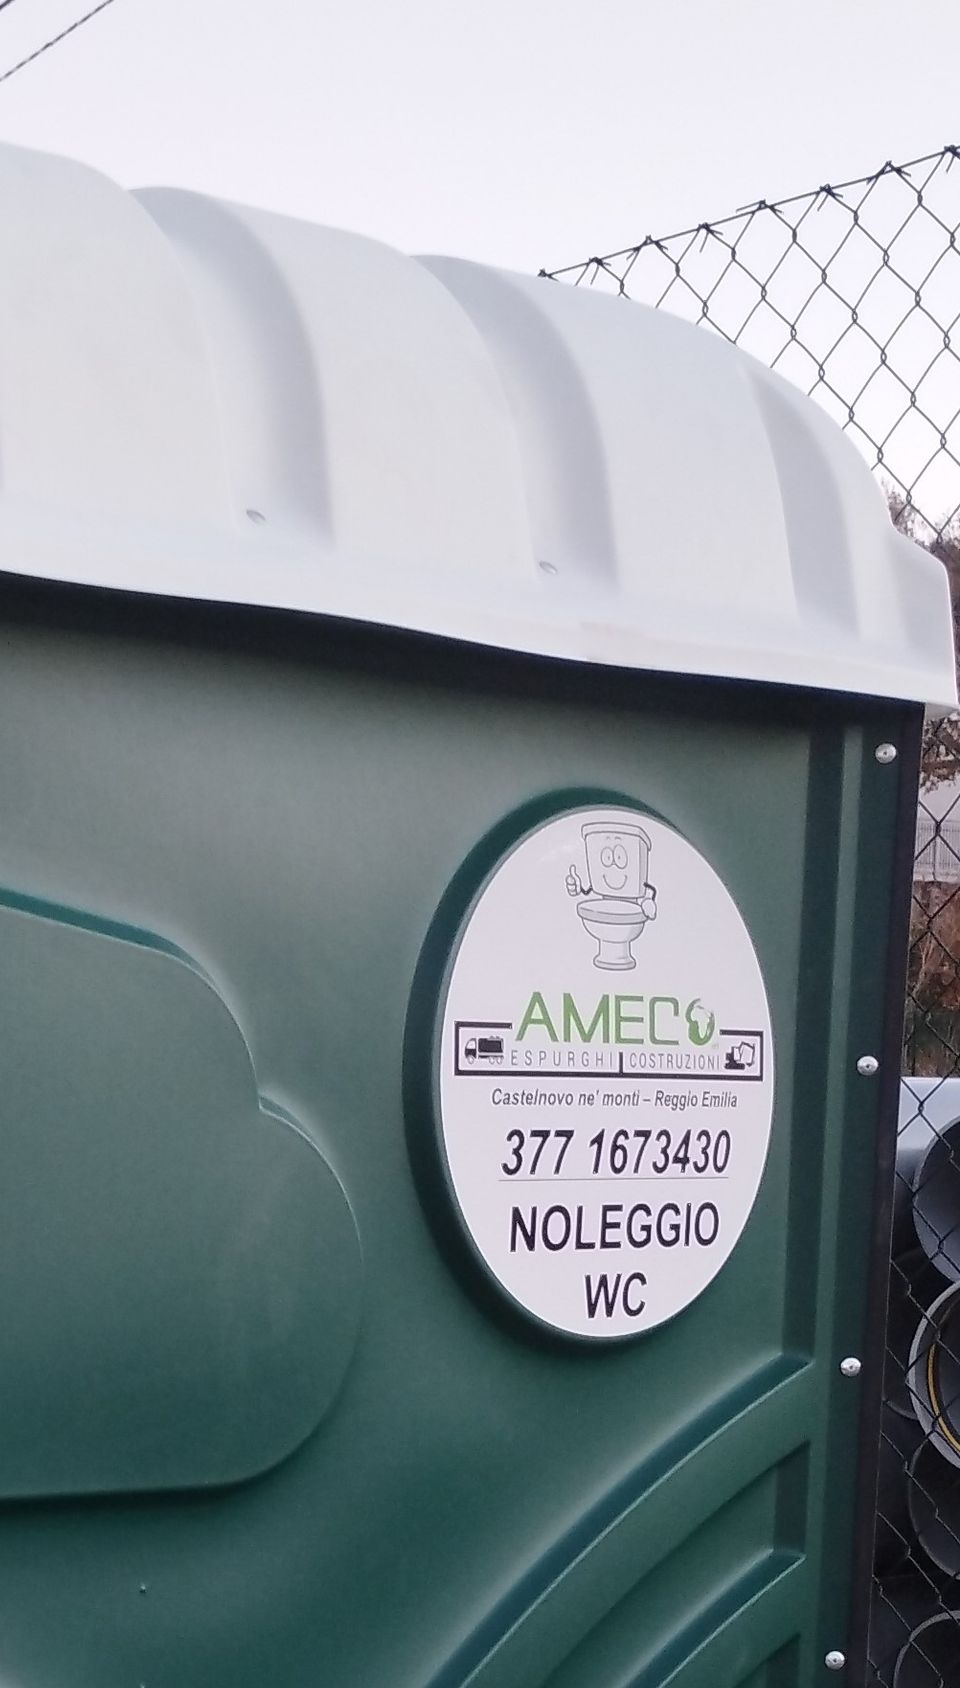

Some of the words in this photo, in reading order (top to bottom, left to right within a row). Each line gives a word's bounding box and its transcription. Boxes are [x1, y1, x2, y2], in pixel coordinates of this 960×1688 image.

[510, 1049, 614, 1068] ESPURGHI
[629, 1053, 721, 1071] COSTRUZIONI
[491, 1087, 574, 1107] Castelnovo
[578, 1089, 600, 1107] ne'
[602, 1090, 640, 1108] monti
[654, 1089, 699, 1112] Reggio
[701, 1090, 739, 1109] Emilia
[501, 1128, 575, 1177] 377
[589, 1127, 732, 1176] 1673430
[510, 1201, 720, 1253] NOLEGGIO
[584, 1271, 648, 1320] WC
